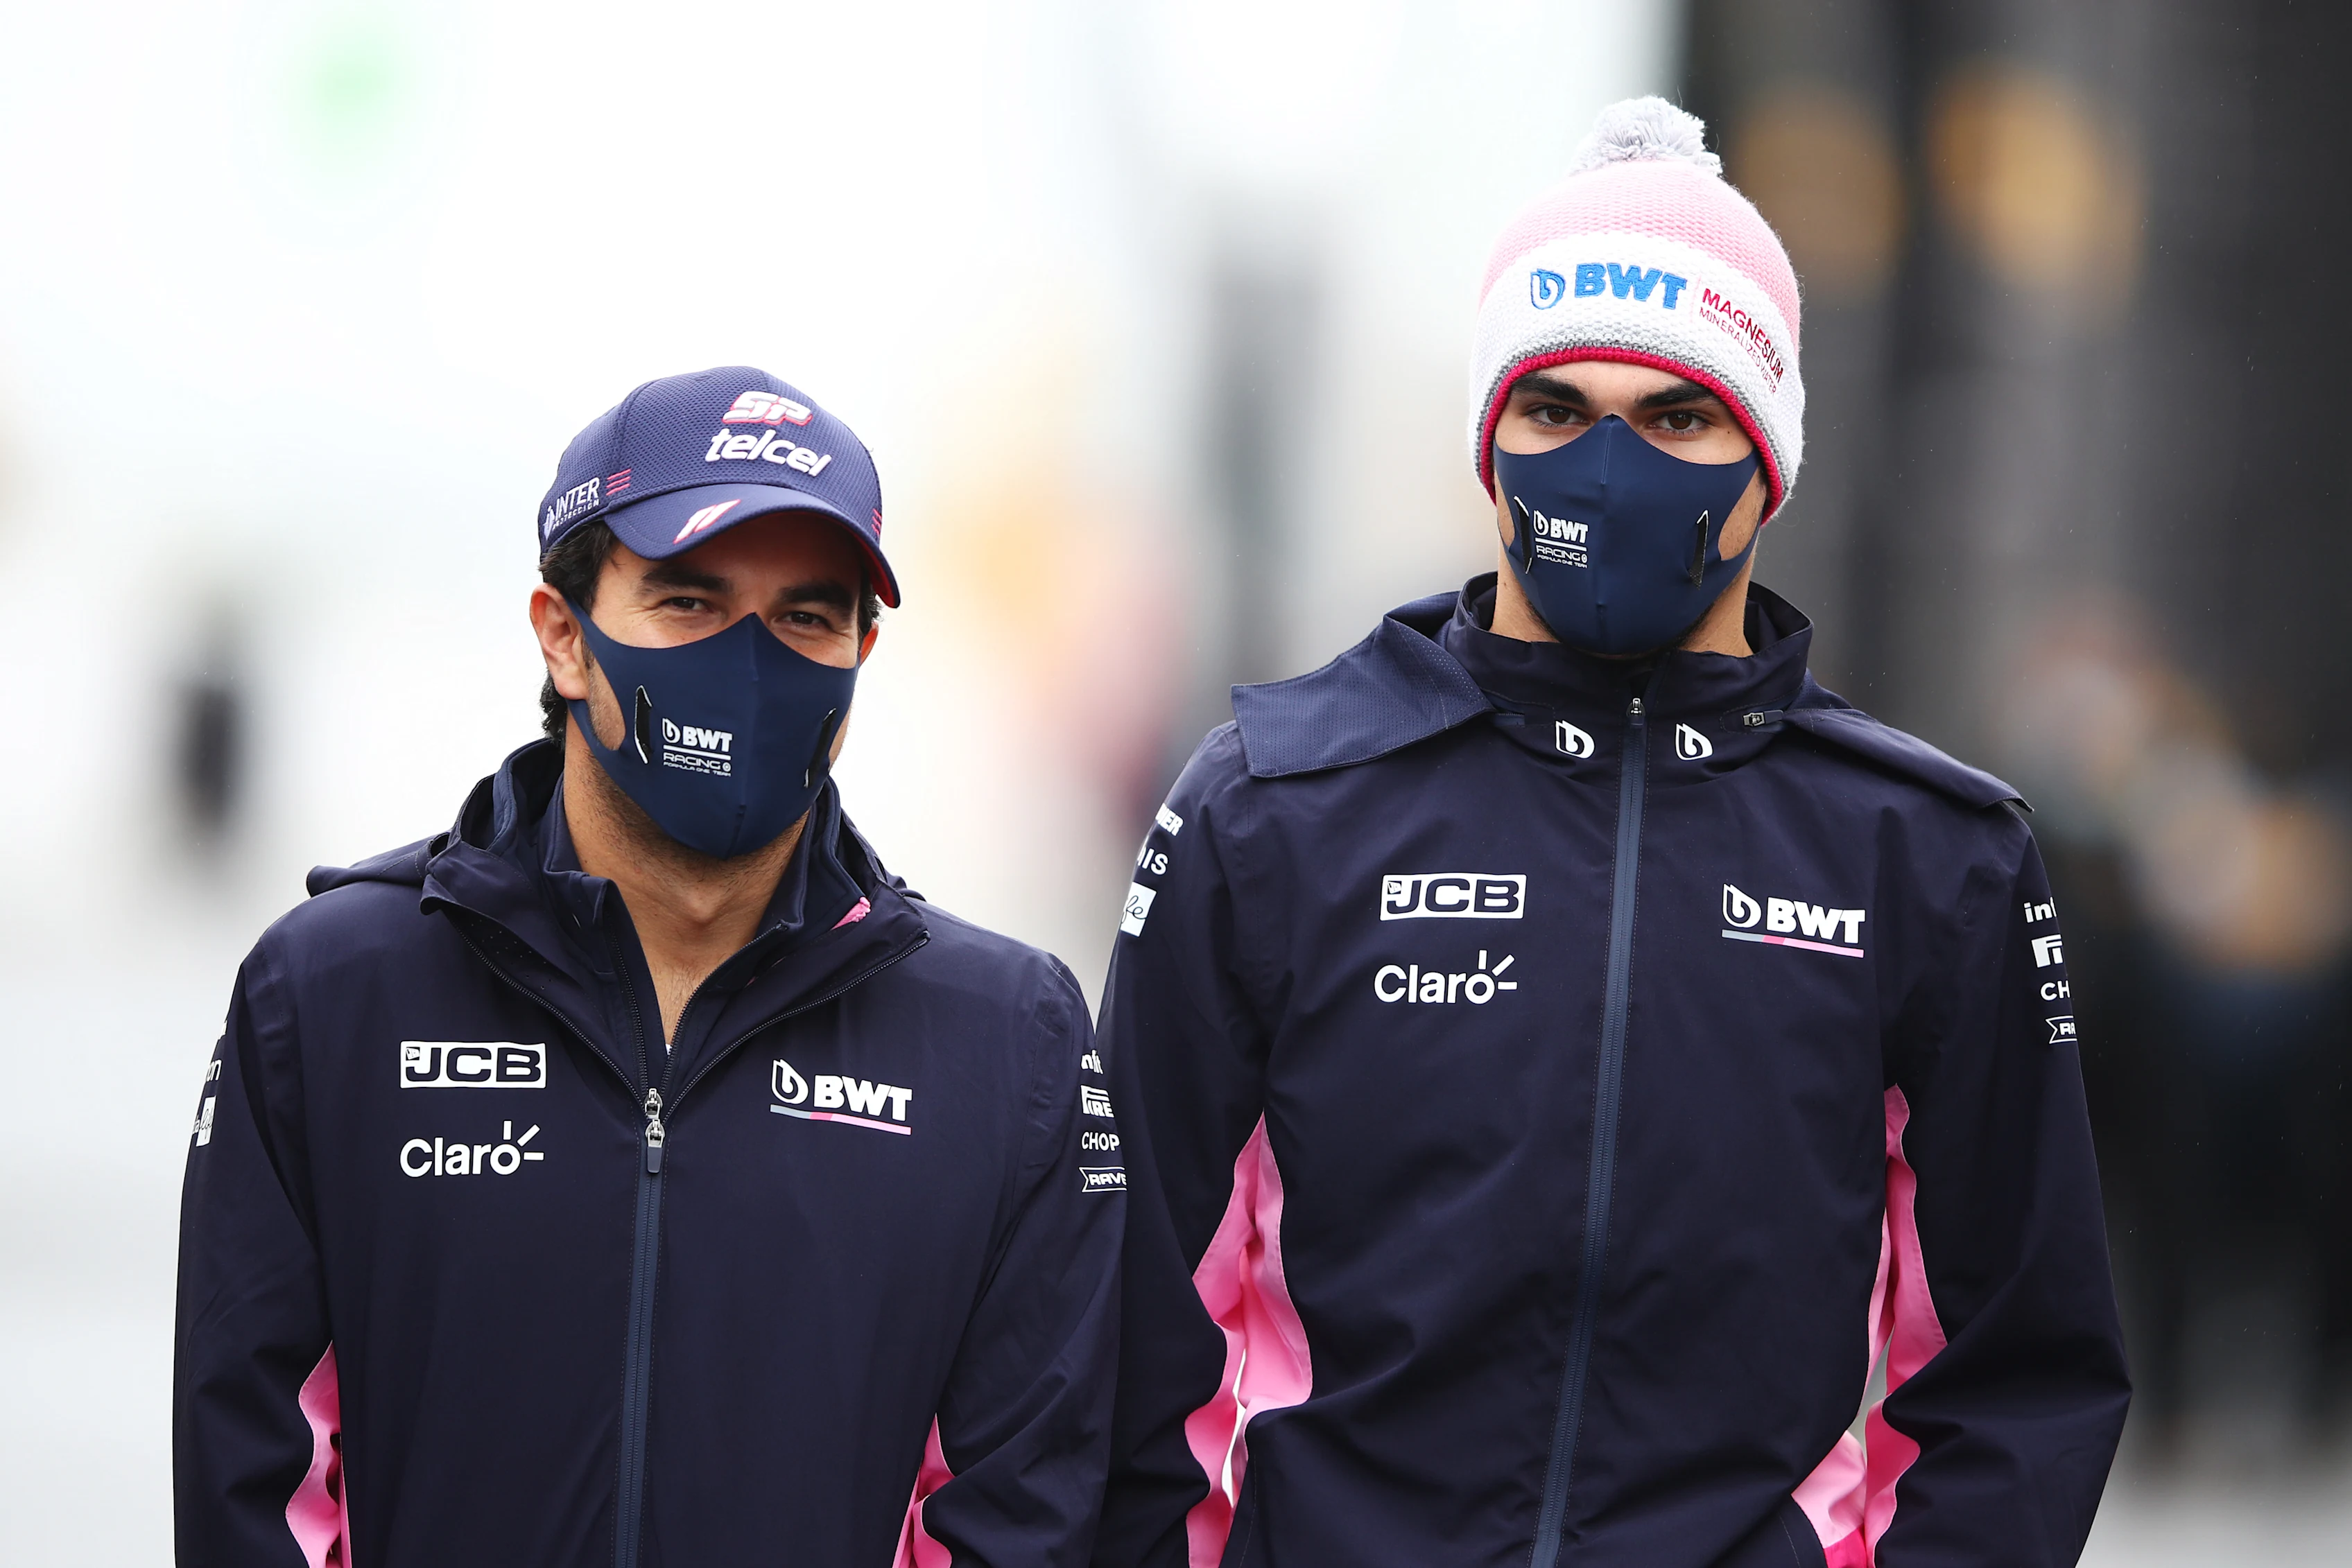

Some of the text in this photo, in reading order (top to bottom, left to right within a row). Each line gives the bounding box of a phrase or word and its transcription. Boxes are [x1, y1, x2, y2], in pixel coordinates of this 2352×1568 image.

[1575, 263, 1688, 309] BWT
[1700, 306, 1761, 367] MINERALIZED
[1702, 288, 1783, 383] MAGNESIUM
[704, 428, 832, 477] telcel
[555, 476, 600, 523] INTER
[1550, 517, 1589, 543] BWT
[1536, 545, 1581, 561] RACING
[1537, 554, 1562, 564] FORMULA
[682, 725, 733, 752] BWT
[663, 752, 721, 769] RACING
[663, 761, 695, 771] FORMULA
[1387, 878, 1519, 915] JCB
[1766, 896, 1866, 944] BWT
[1374, 964, 1496, 1005] Claro
[405, 1047, 542, 1083] JCB
[813, 1074, 913, 1122] BWT
[399, 1136, 521, 1178] Claro
